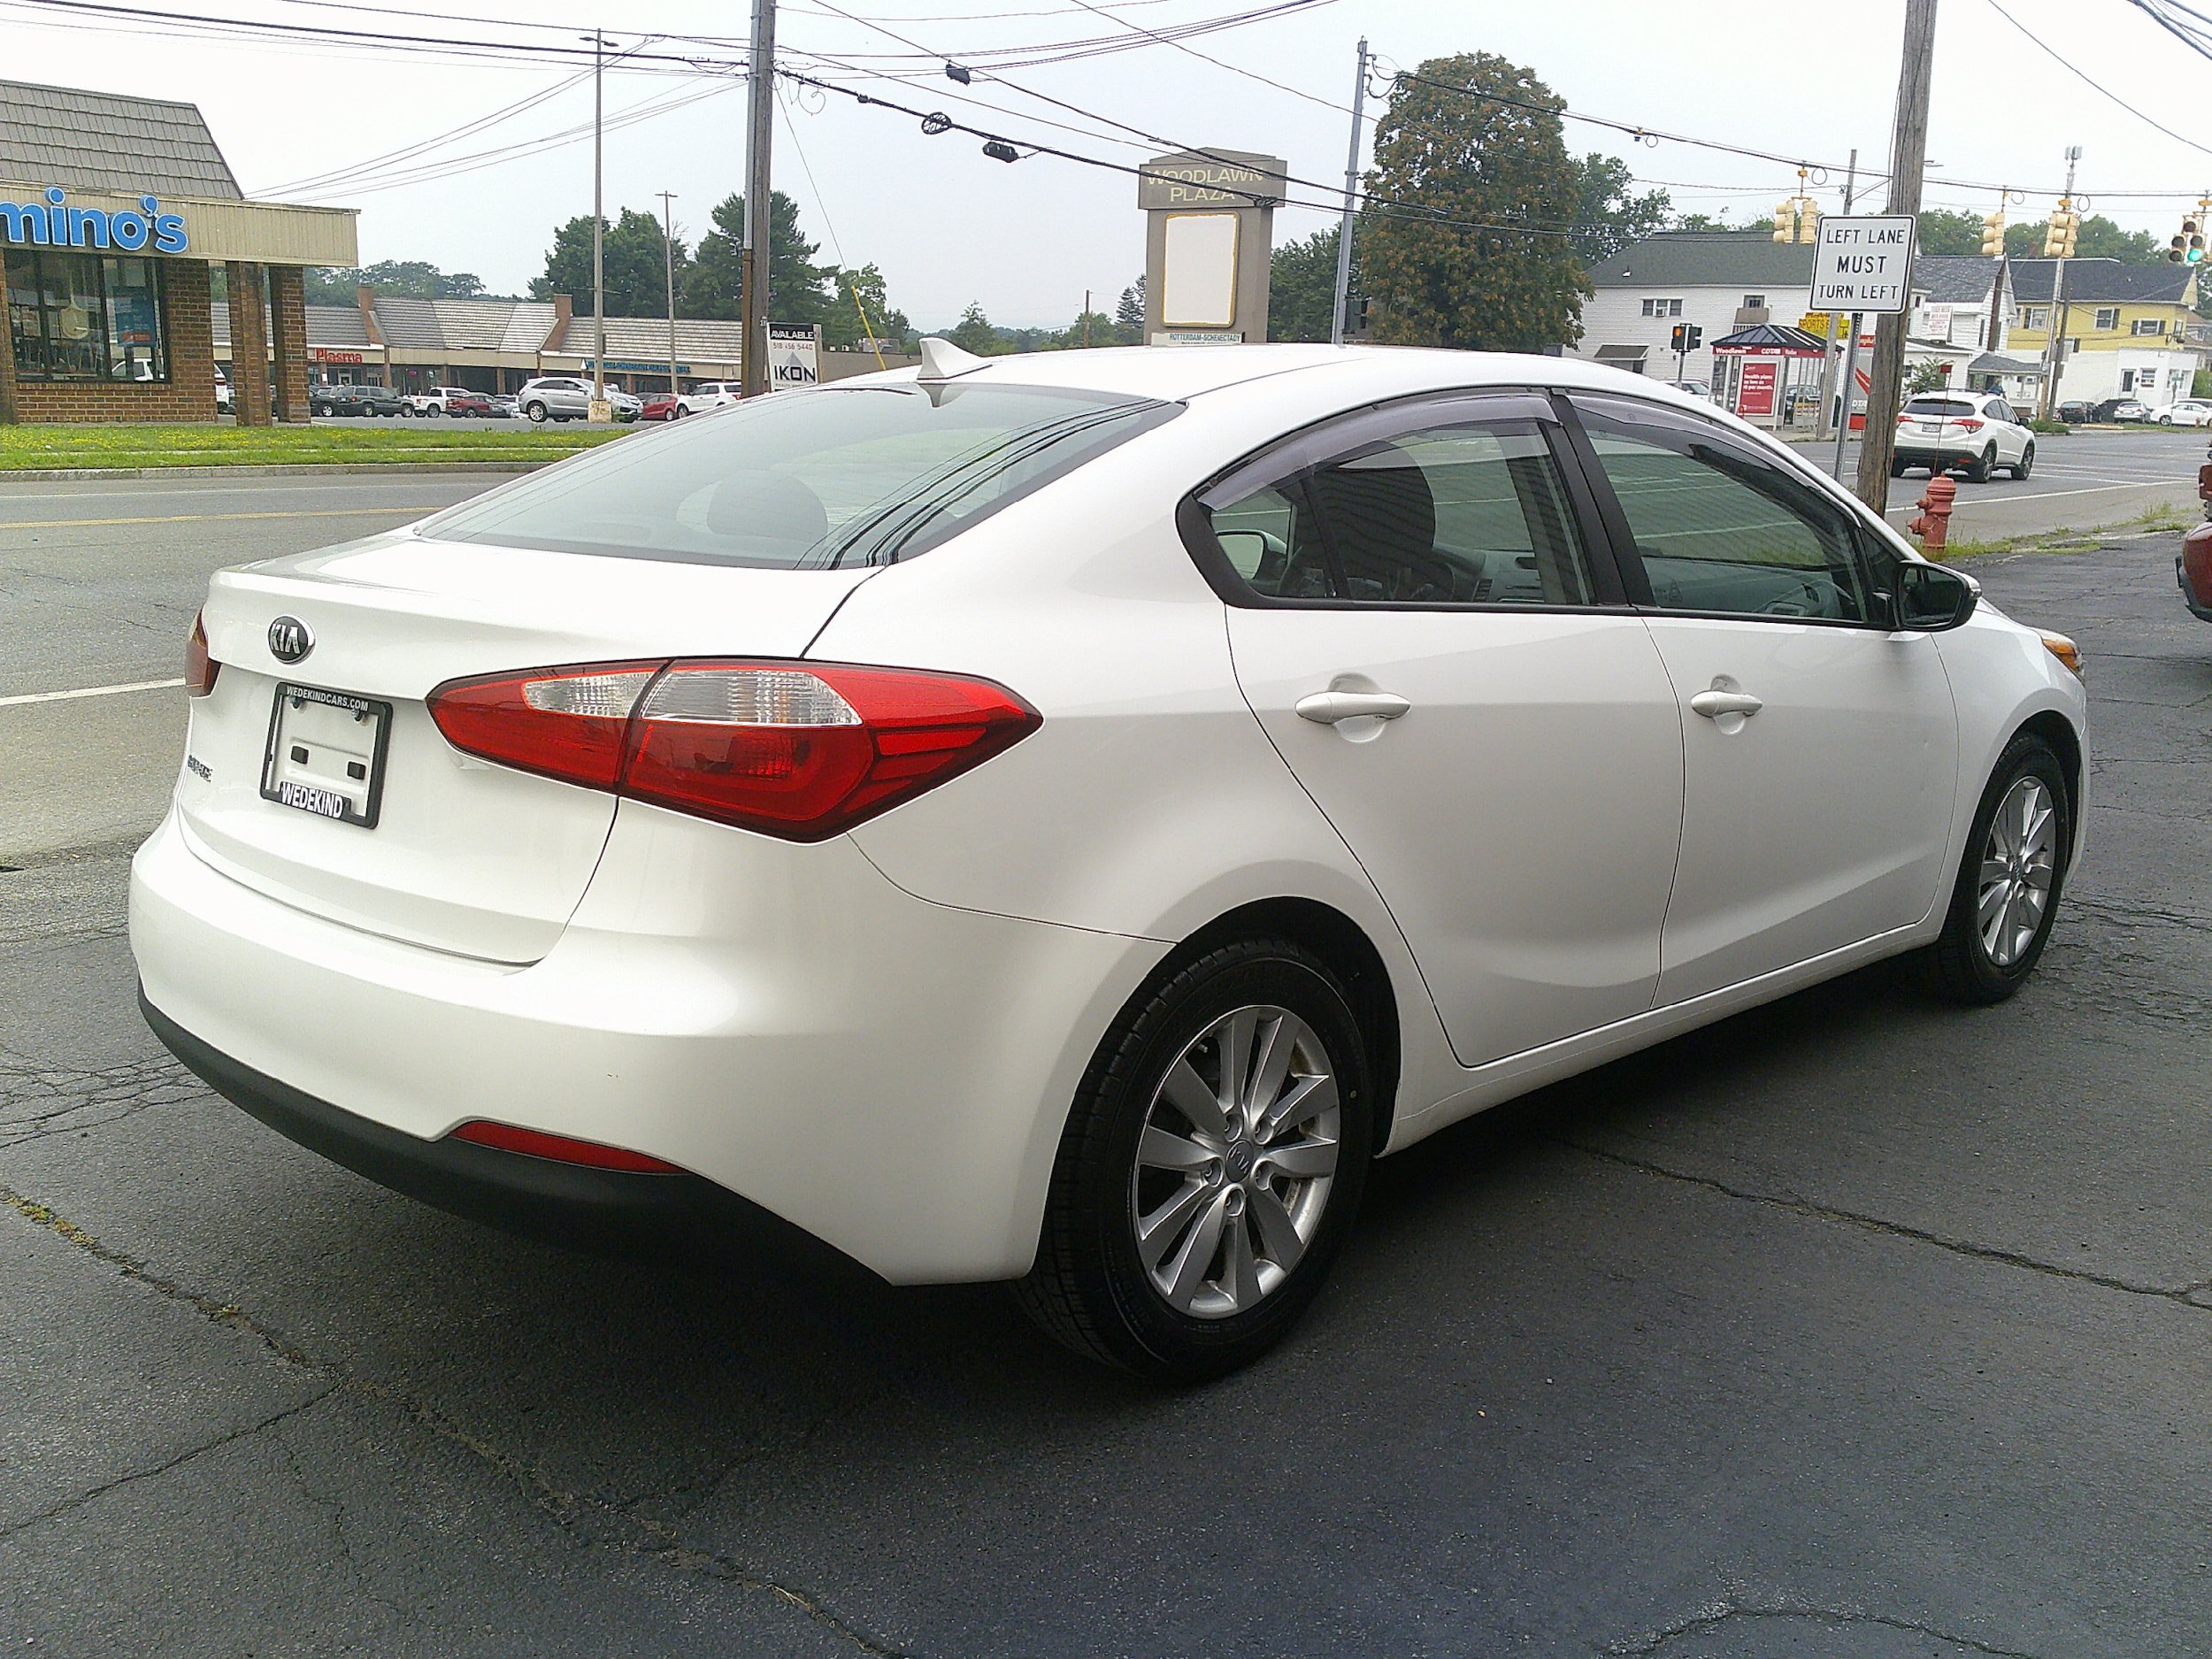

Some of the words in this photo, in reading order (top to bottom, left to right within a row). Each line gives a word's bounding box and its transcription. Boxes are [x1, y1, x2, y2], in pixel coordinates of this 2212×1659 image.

[1147, 167, 1263, 185] WOODLAWN
[1170, 187, 1235, 203] PLAZA
[1826, 229, 1862, 244] LEFT
[1868, 229, 1905, 244] LANE
[1836, 256, 1887, 273] MUST
[1819, 285, 1854, 299] TURN
[1861, 285, 1899, 299] LEFT
[1798, 319, 1824, 330] SPORTS
[316, 348, 363, 364] Plasma
[774, 365, 816, 381] IKON
[270, 623, 301, 654] KIA
[286, 685, 369, 711] WEDEKINDCARS.COM
[280, 781, 343, 818] WEDEKIND
